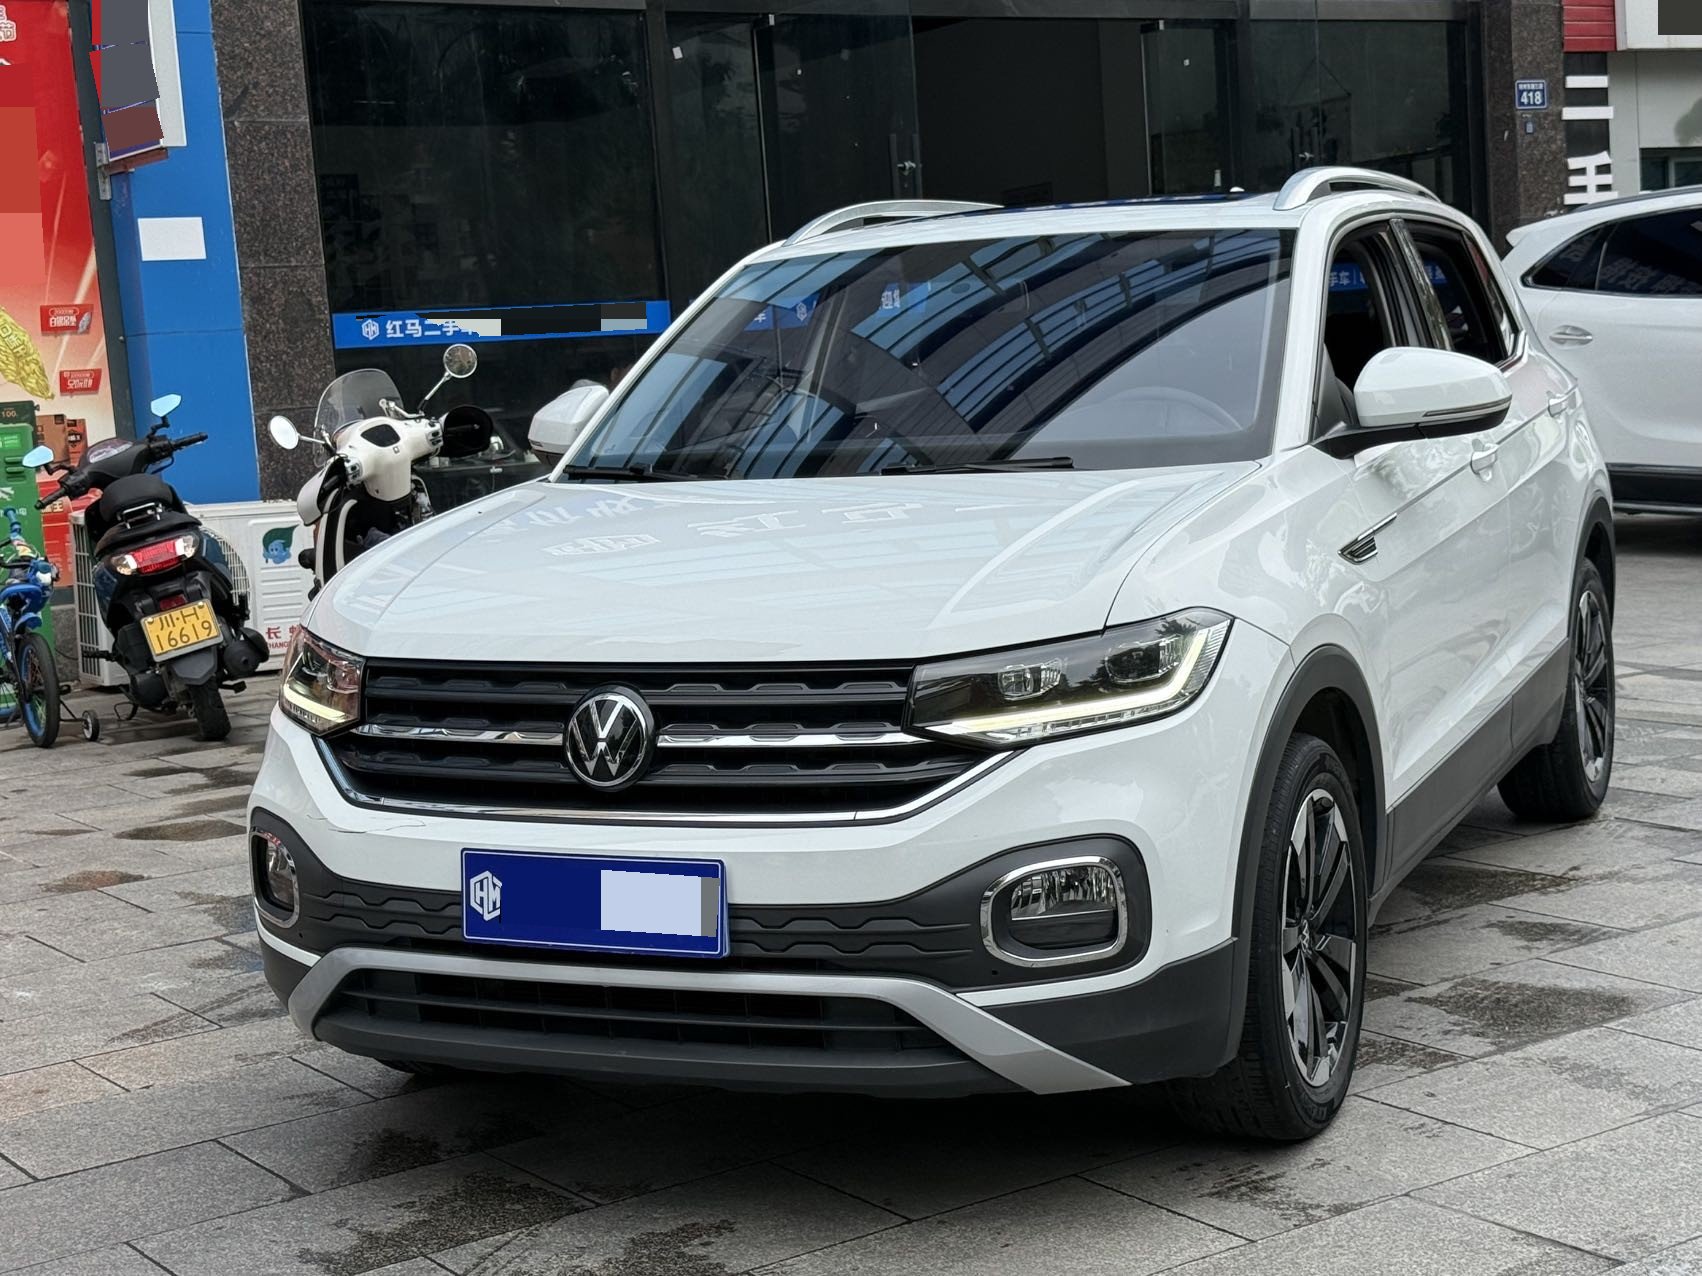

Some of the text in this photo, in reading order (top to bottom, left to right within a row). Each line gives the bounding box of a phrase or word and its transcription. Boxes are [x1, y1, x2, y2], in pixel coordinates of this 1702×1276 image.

[1521, 91, 1542, 105] 418
[386, 318, 480, 338] 红马二手
[156, 620, 212, 651] 16619
[268, 641, 289, 649] HANG
